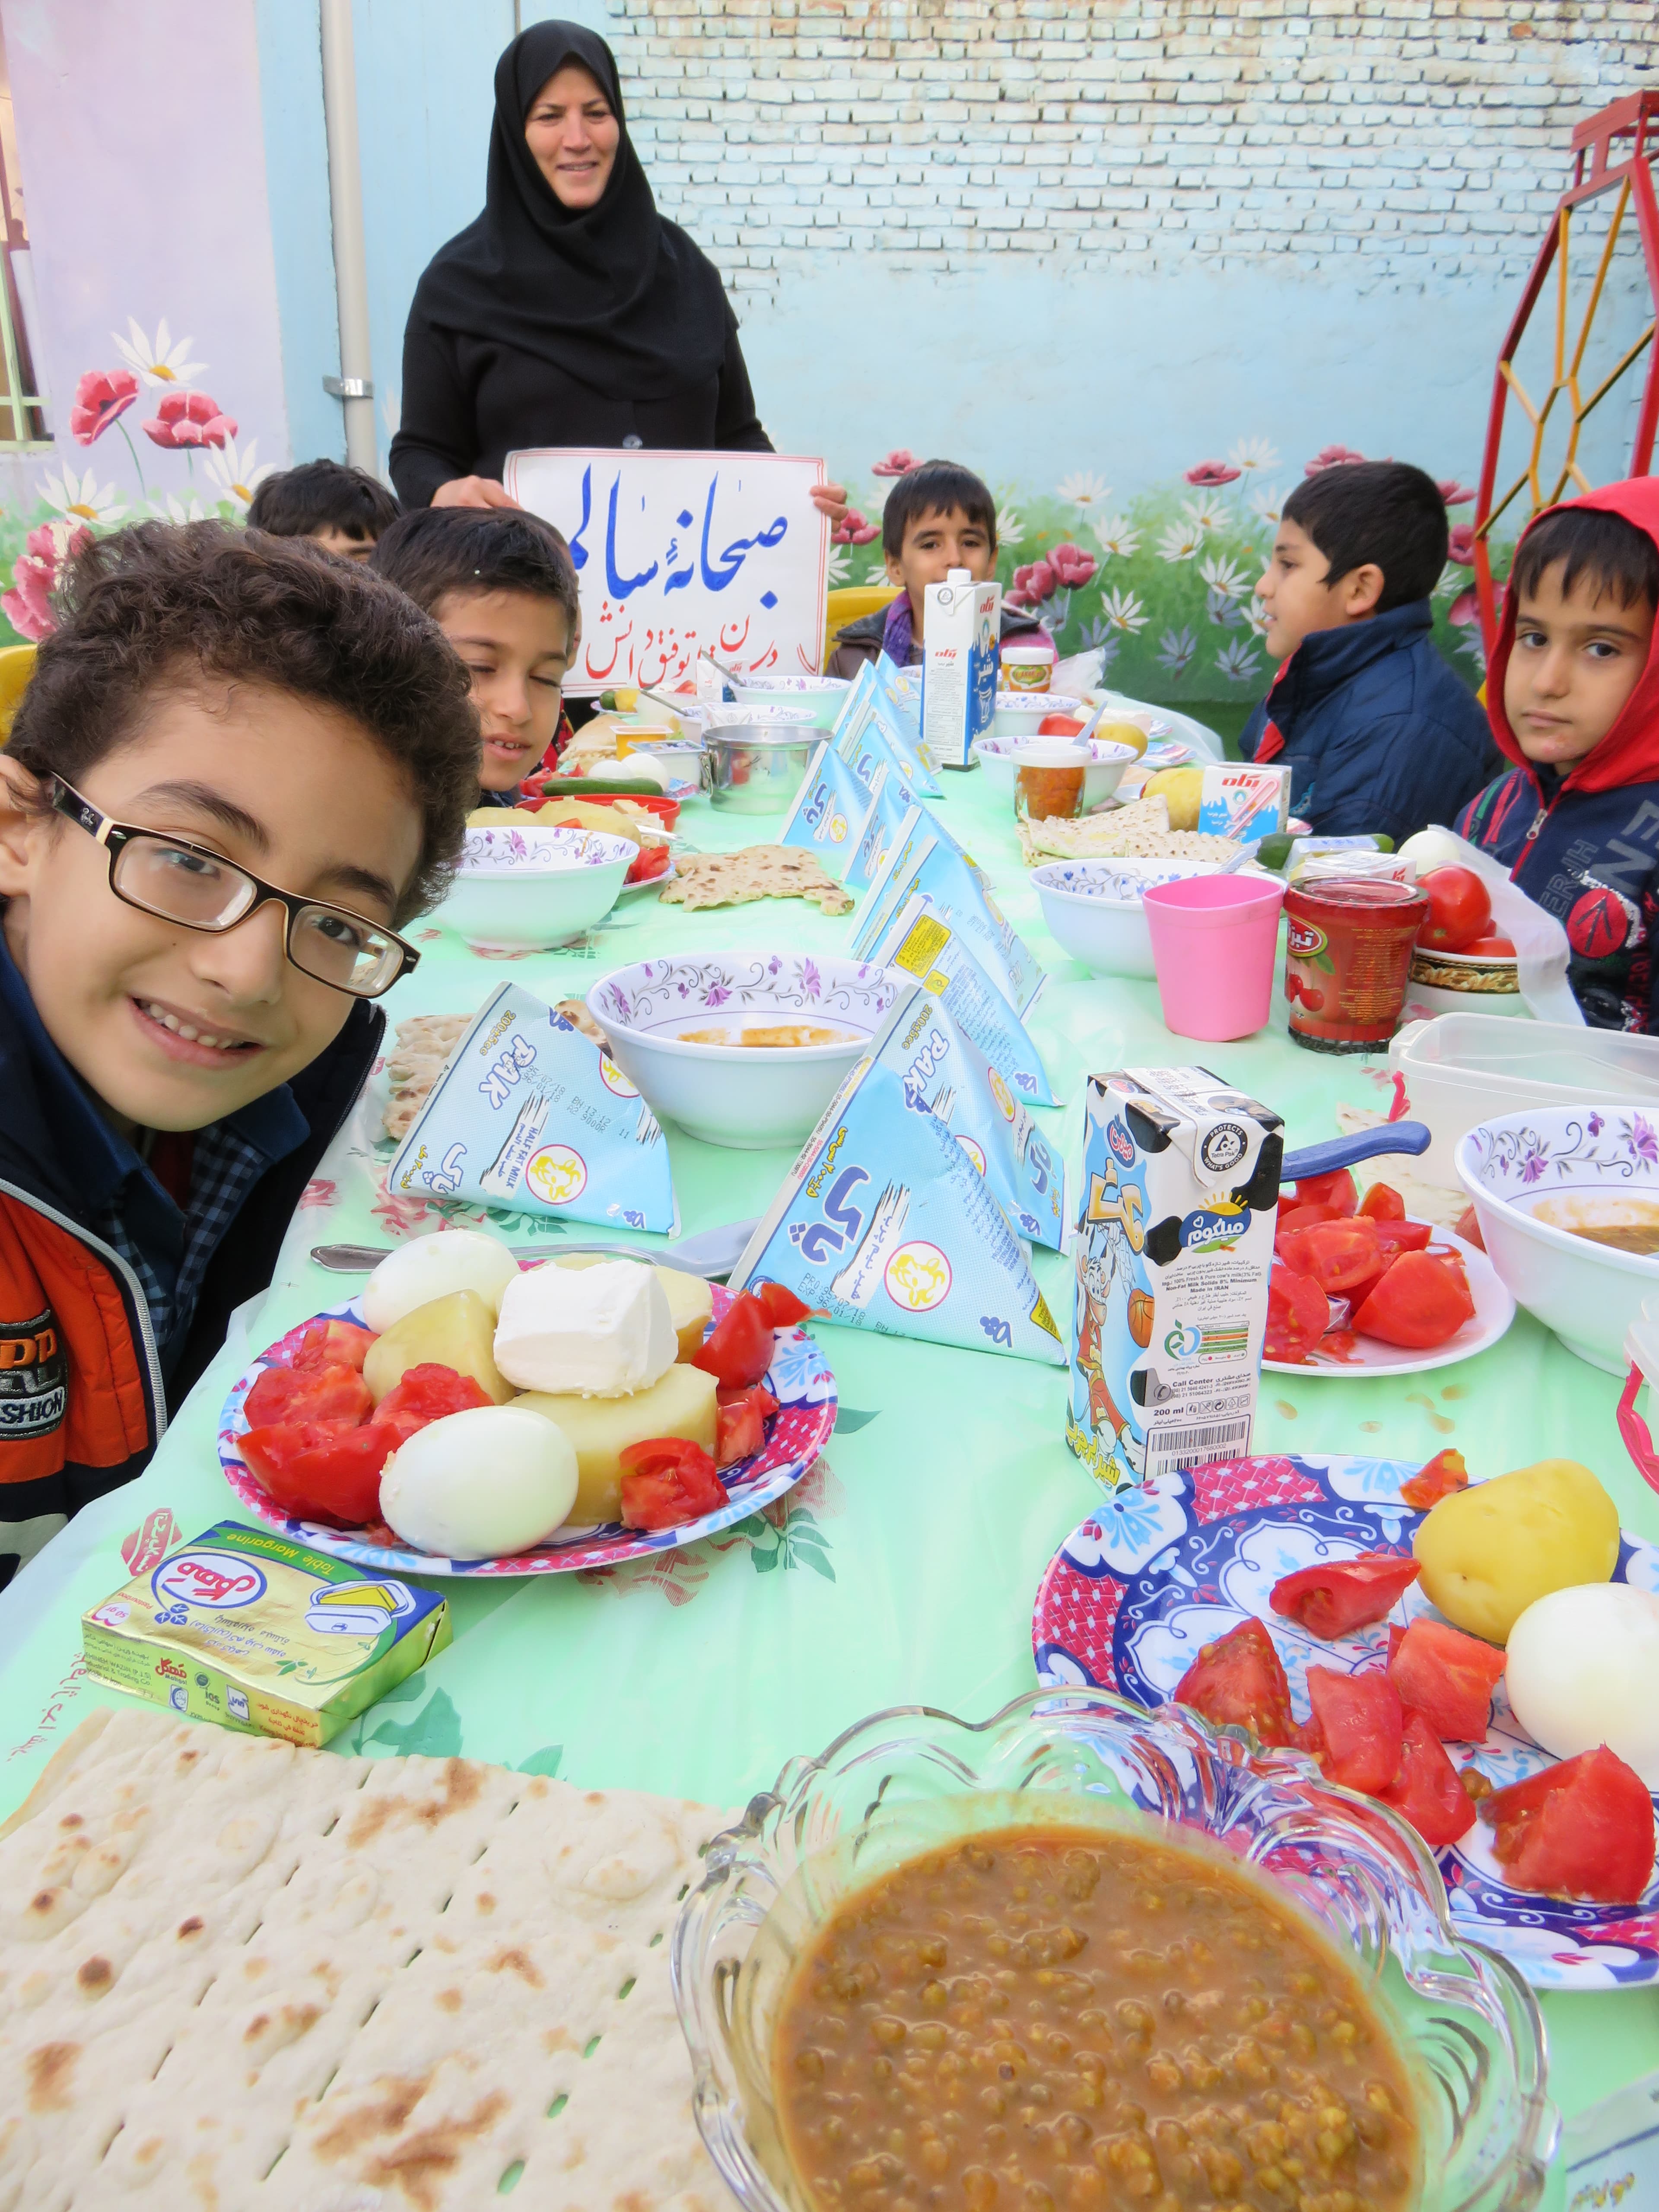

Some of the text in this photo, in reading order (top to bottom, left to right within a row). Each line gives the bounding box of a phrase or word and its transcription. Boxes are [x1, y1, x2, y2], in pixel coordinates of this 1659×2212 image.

[479, 1034, 537, 1110] PAK
[902, 1029, 950, 1093] PAK
[1210, 1125, 1243, 1137] PROTECTS
[423, 1142, 467, 1194] پاک
[506, 1127, 538, 1189] HALF FAT MILK
[1204, 1153, 1243, 1170] WHAT'S GOOD
[788, 1166, 872, 1266] پاک
[851, 1270, 865, 1300] شیر
[225, 1532, 335, 1576] Table Margarine
[118, 1671, 139, 1684] Trading
